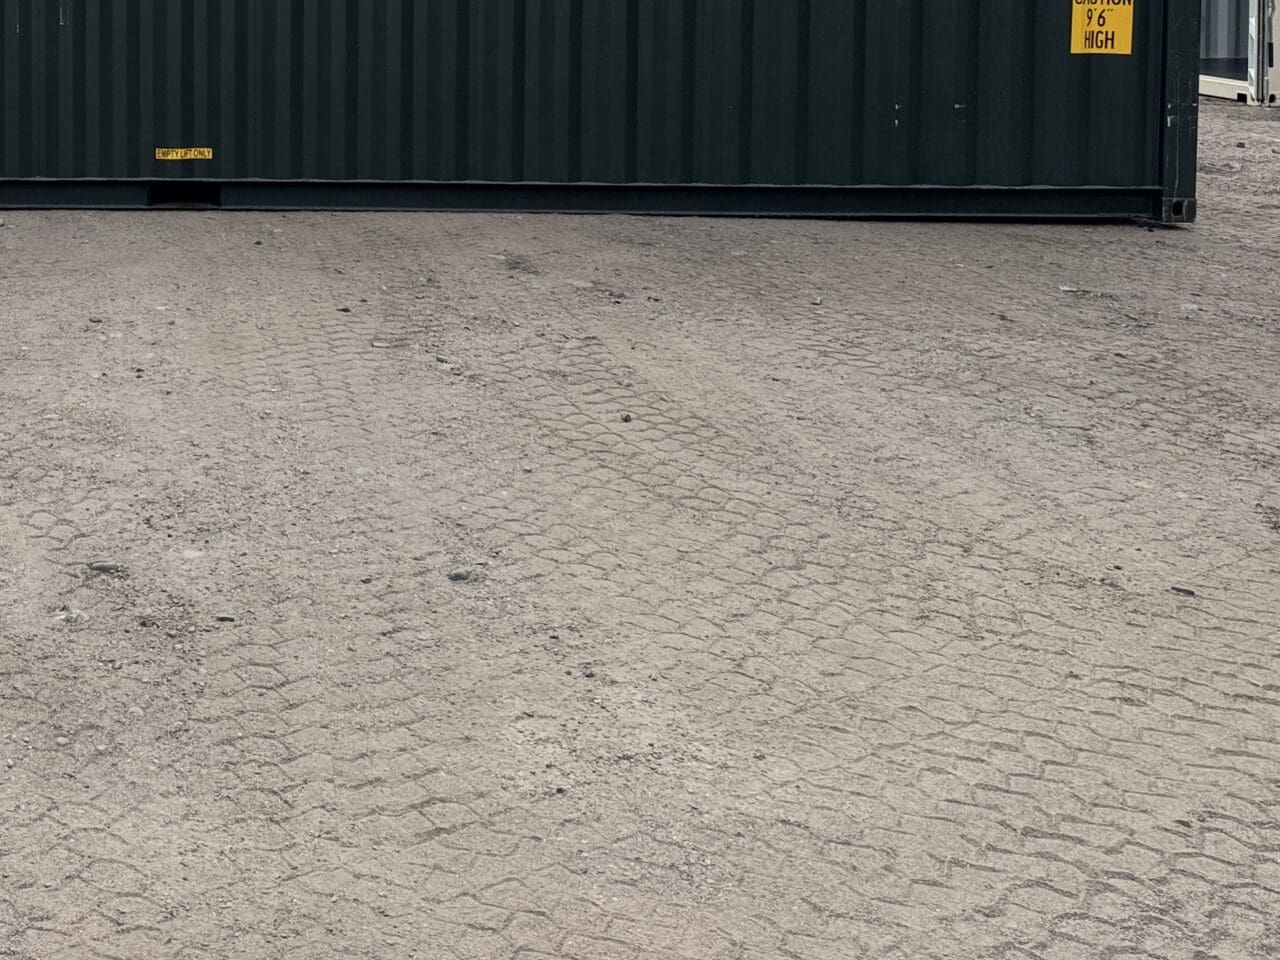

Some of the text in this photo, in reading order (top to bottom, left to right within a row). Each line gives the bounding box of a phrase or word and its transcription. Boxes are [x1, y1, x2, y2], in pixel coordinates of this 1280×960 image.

[1084, 30, 1115, 50] HIGH
[157, 149, 211, 159] EMPTY LIFT ONLY
